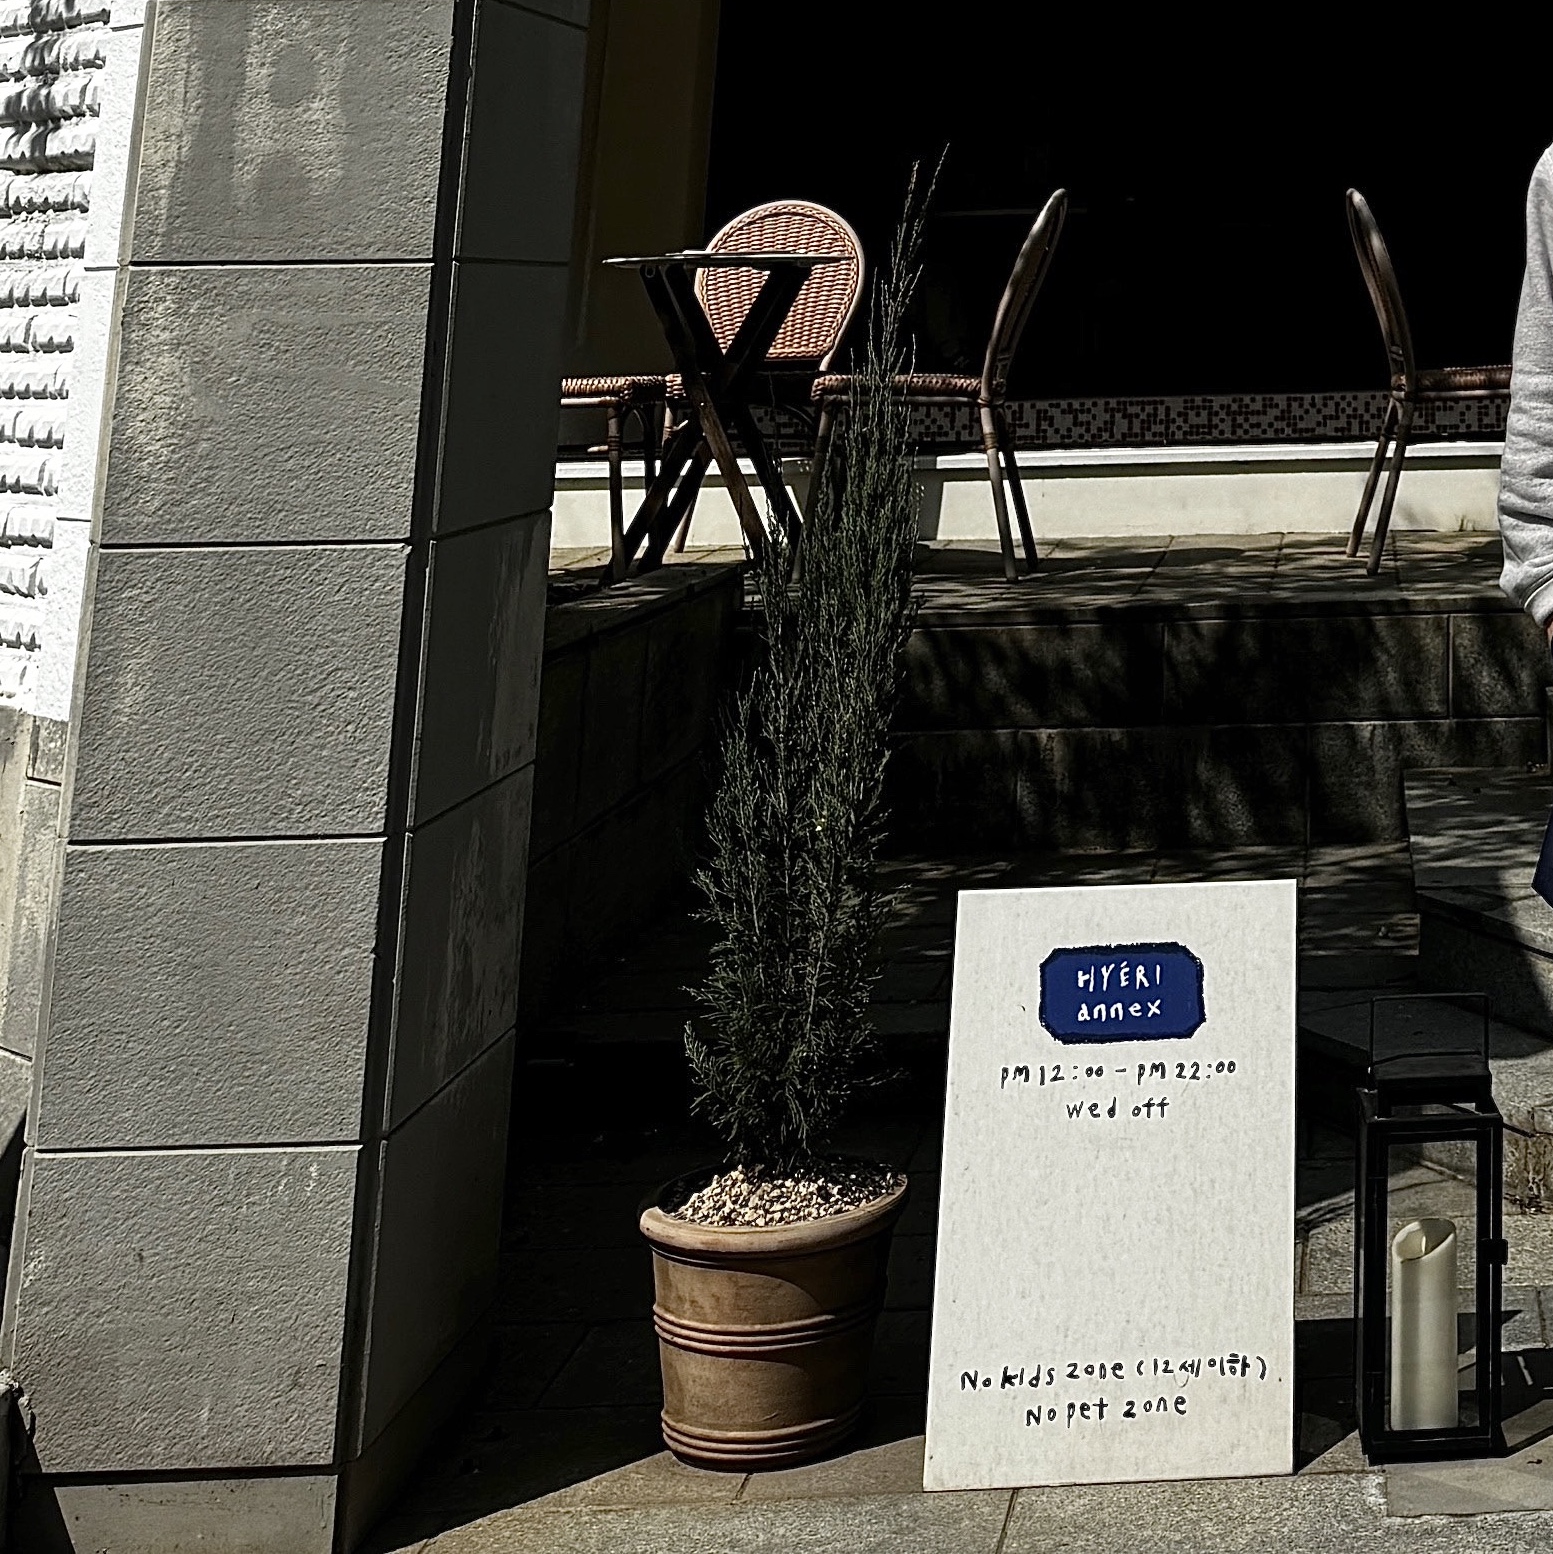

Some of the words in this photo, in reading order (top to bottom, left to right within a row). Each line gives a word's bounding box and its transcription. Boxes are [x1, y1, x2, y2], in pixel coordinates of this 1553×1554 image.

[1077, 999, 1161, 1022] annex
[1039, 1064, 1104, 1086] 12:00
[1175, 1060, 1236, 1081] 22:00
[1066, 1096, 1117, 1119] wed
[1131, 1096, 1170, 1119] off
[960, 1370, 992, 1391] No
[1000, 1364, 1055, 1390] kids
[1066, 1362, 1125, 1380] zone
[1026, 1405, 1057, 1427] No
[1066, 1397, 1109, 1428] pet
[1122, 1395, 1187, 1419] zone
